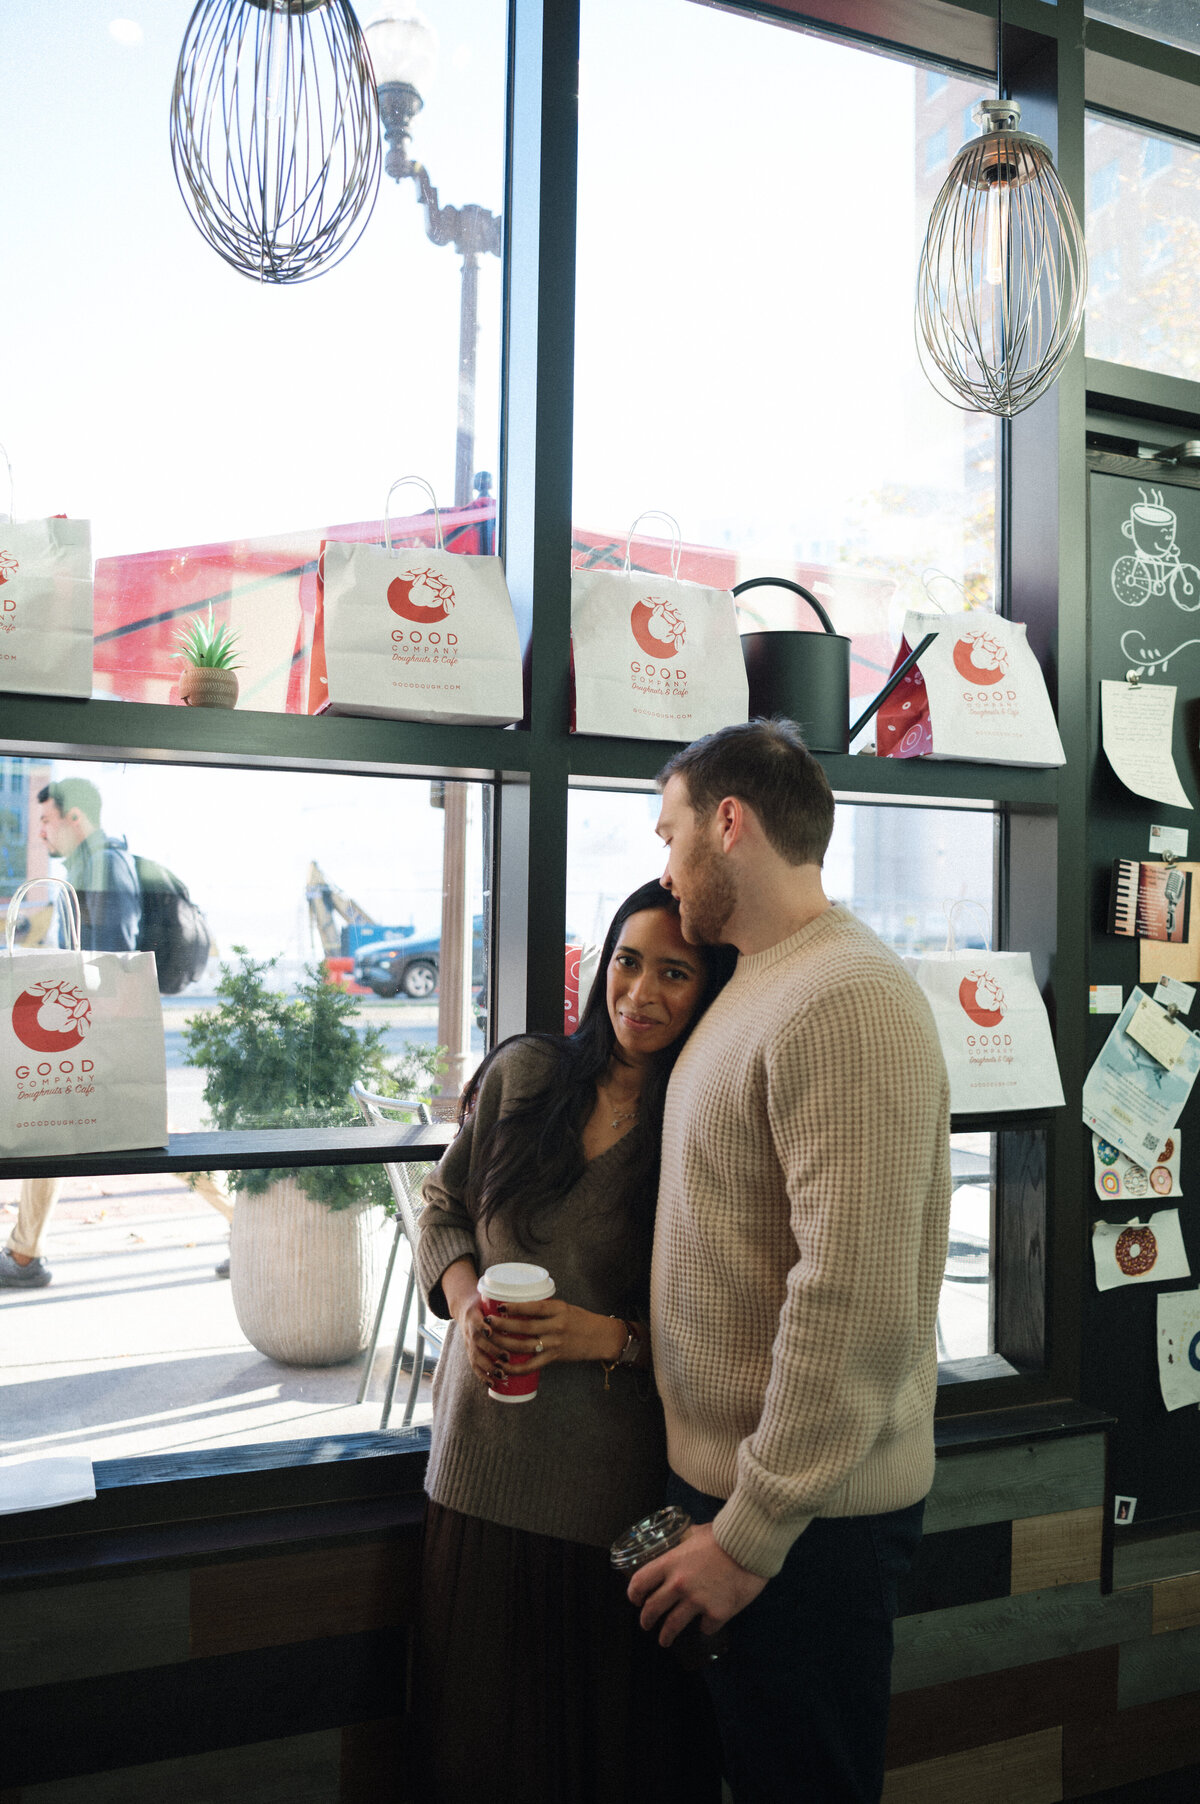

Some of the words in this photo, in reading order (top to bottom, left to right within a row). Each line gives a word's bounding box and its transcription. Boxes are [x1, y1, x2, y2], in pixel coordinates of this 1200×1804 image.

[391, 629, 458, 646] GOOD
[391, 645, 458, 655] COMPANY
[391, 653, 431, 665] Doughnuts
[432, 656, 439, 664] &
[440, 656, 459, 667] Cafe
[630, 661, 687, 680] GOOD
[631, 674, 688, 688] COMPANY
[664, 688, 671, 696] &
[672, 688, 689, 698] Cafe
[963, 690, 1017, 702] GOOD
[966, 1034, 1013, 1047] GOOD
[15, 1059, 95, 1080] GOOD
[16, 1074, 95, 1090] COMPANY
[17, 1087, 63, 1102] Doughnuts
[64, 1084, 73, 1095] &
[74, 1084, 96, 1097] Cafe
[16, 1118, 97, 1129] GOCODOUGH.COM
